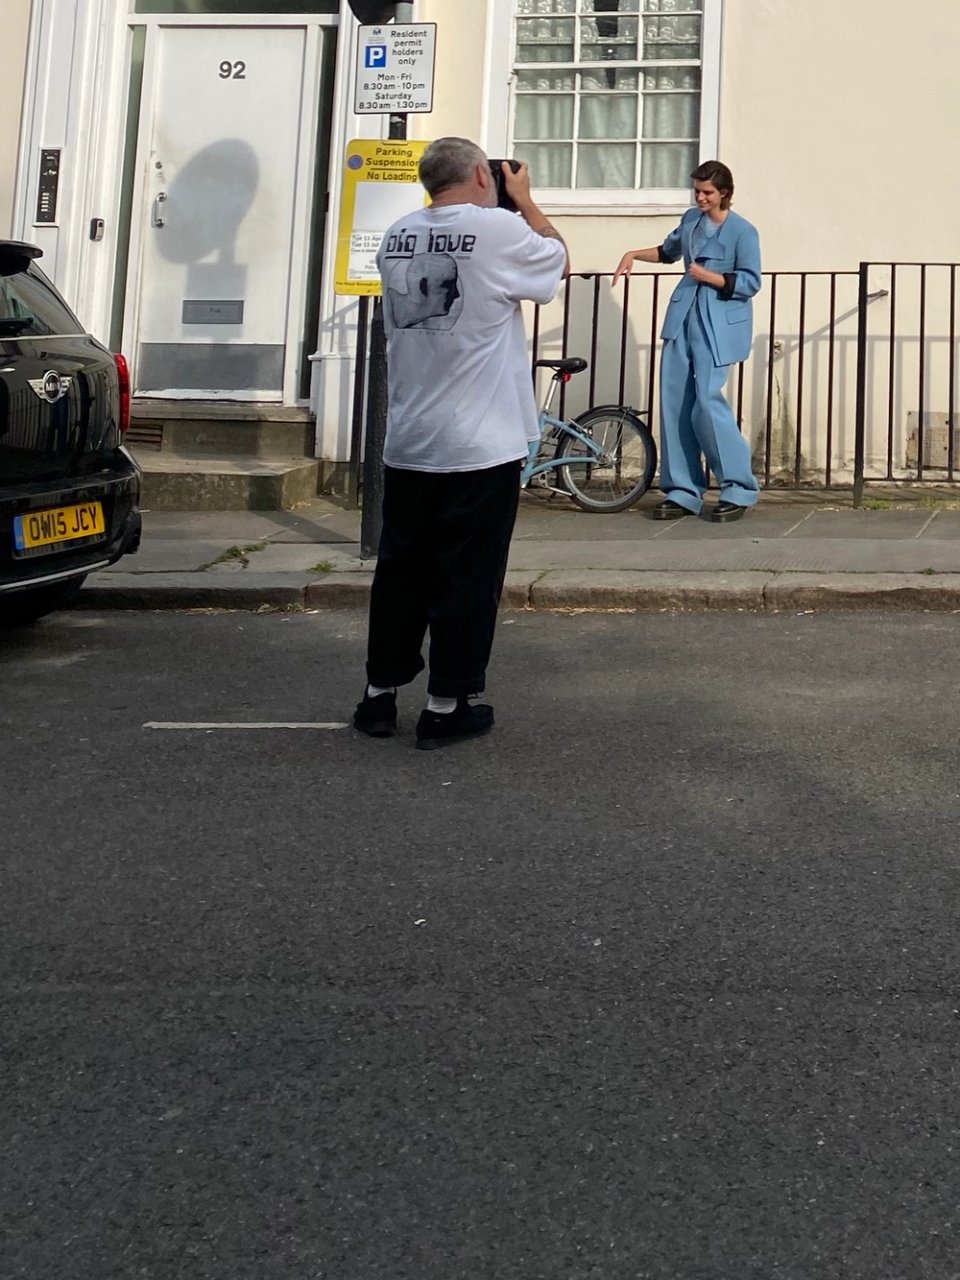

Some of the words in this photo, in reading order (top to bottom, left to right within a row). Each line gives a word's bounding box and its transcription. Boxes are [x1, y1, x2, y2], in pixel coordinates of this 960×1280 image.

[391, 30, 427, 38] Resident
[394, 39, 422, 47] permit
[392, 47, 424, 55] holders
[369, 47, 384, 66] P
[398, 57, 416, 66] only
[219, 60, 246, 79] 92
[375, 92, 412, 100] Saturday
[376, 148, 412, 158] Parking
[367, 172, 380, 180] No
[383, 172, 417, 182] Loading
[427, 228, 476, 252] love
[72, 505, 96, 533] JCY
